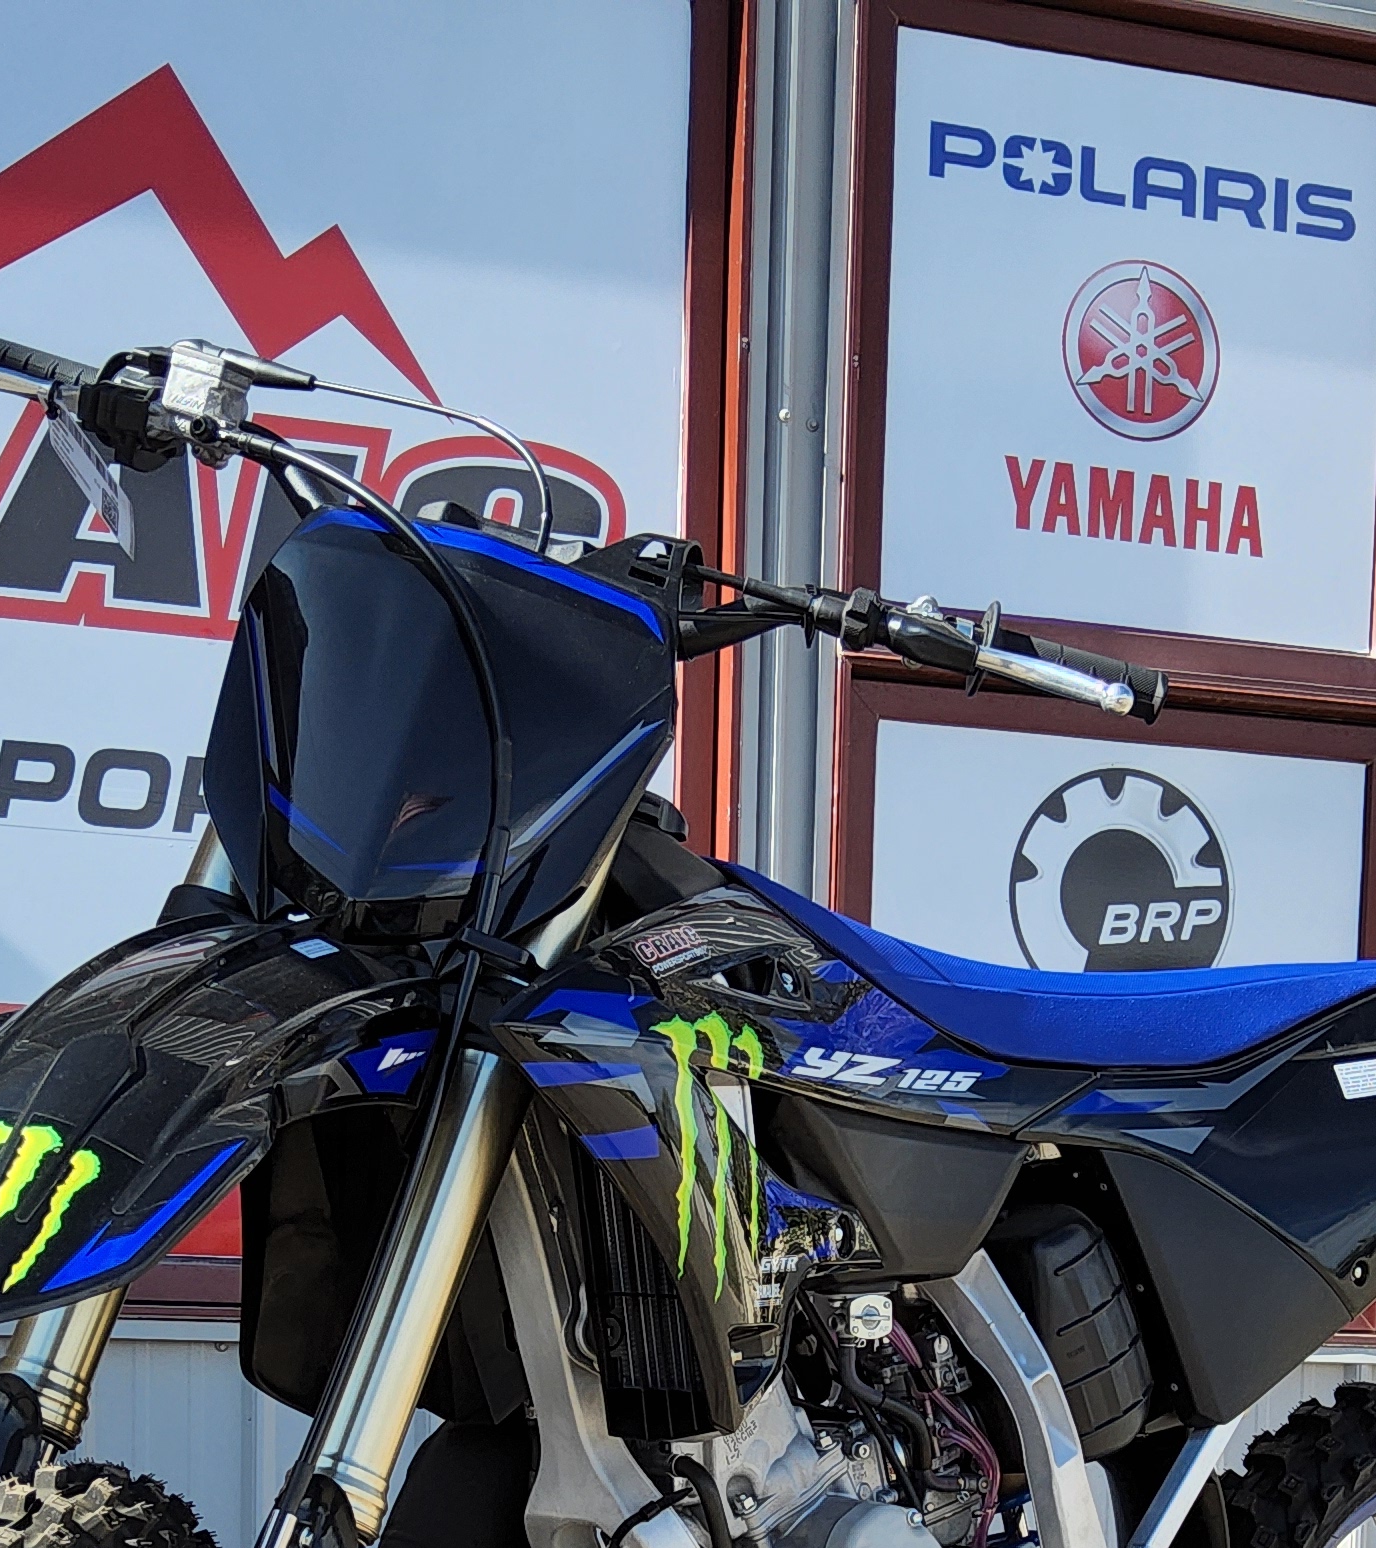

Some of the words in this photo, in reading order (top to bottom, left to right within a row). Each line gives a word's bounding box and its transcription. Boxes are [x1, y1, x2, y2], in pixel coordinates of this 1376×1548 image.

[928, 120, 1356, 242] POLARIS
[1004, 454, 1264, 559] YAMAHA
[1098, 898, 1223, 945] BRP
[791, 1046, 903, 1086] YZ
[897, 1068, 983, 1093] 125
